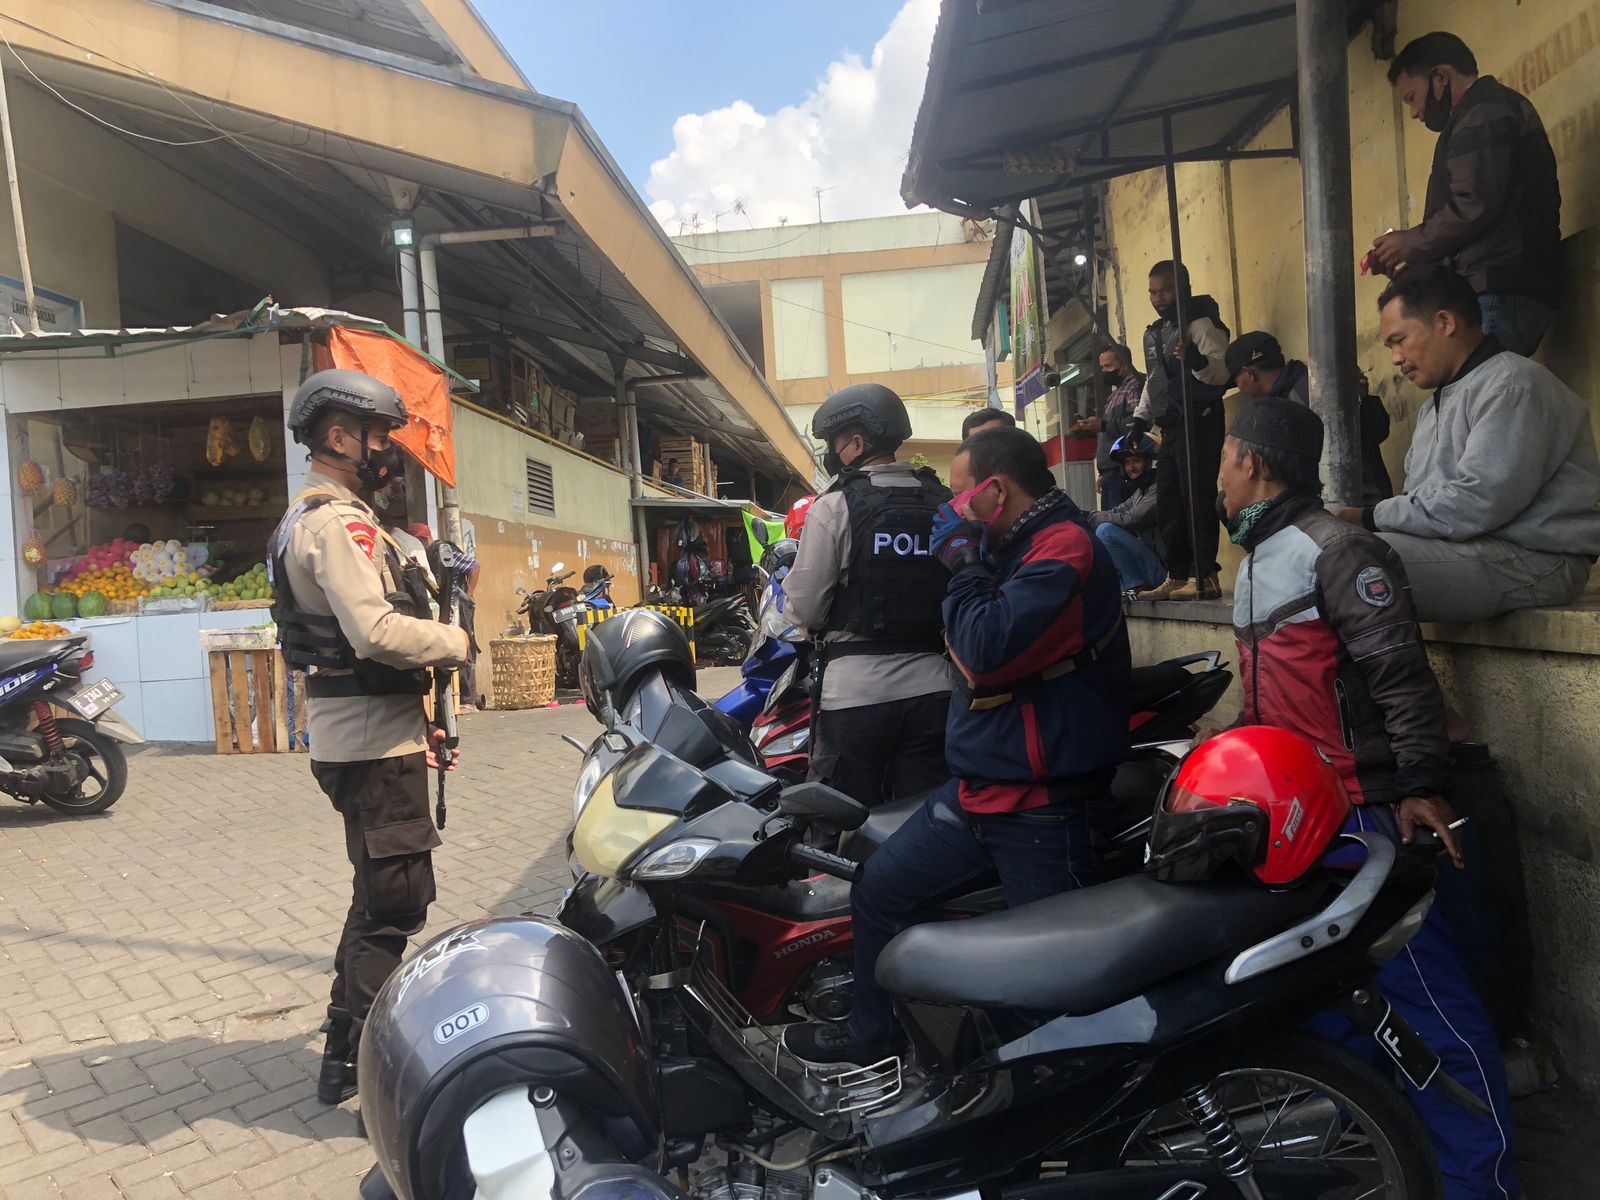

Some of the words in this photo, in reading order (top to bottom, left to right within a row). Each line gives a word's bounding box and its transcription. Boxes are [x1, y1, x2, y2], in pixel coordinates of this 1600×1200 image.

[873, 532, 934, 556] POLI
[773, 929, 838, 960] HONDA
[441, 1007, 483, 1040] DOT
[1383, 1027, 1402, 1058] F
